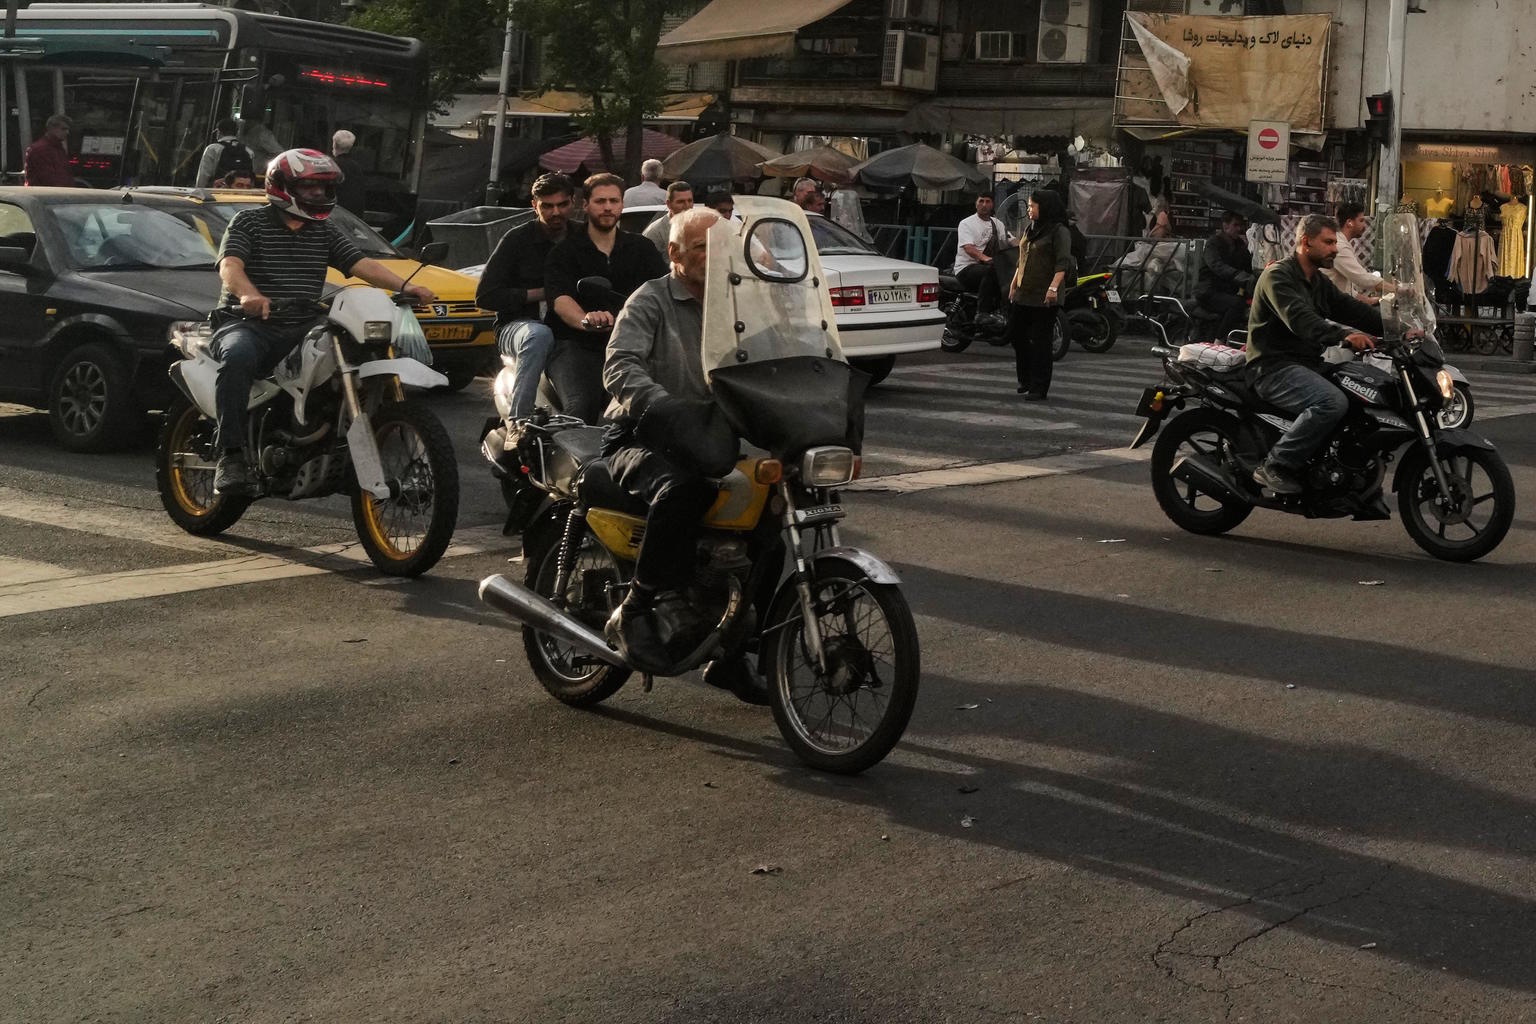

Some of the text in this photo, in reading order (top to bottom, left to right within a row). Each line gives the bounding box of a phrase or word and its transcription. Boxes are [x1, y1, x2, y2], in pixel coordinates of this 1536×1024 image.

[1250, 36, 1256, 49] و
[1259, 30, 1280, 45] لاک
[1281, 31, 1312, 49] دنیای
[1341, 376, 1378, 400] Benelli
